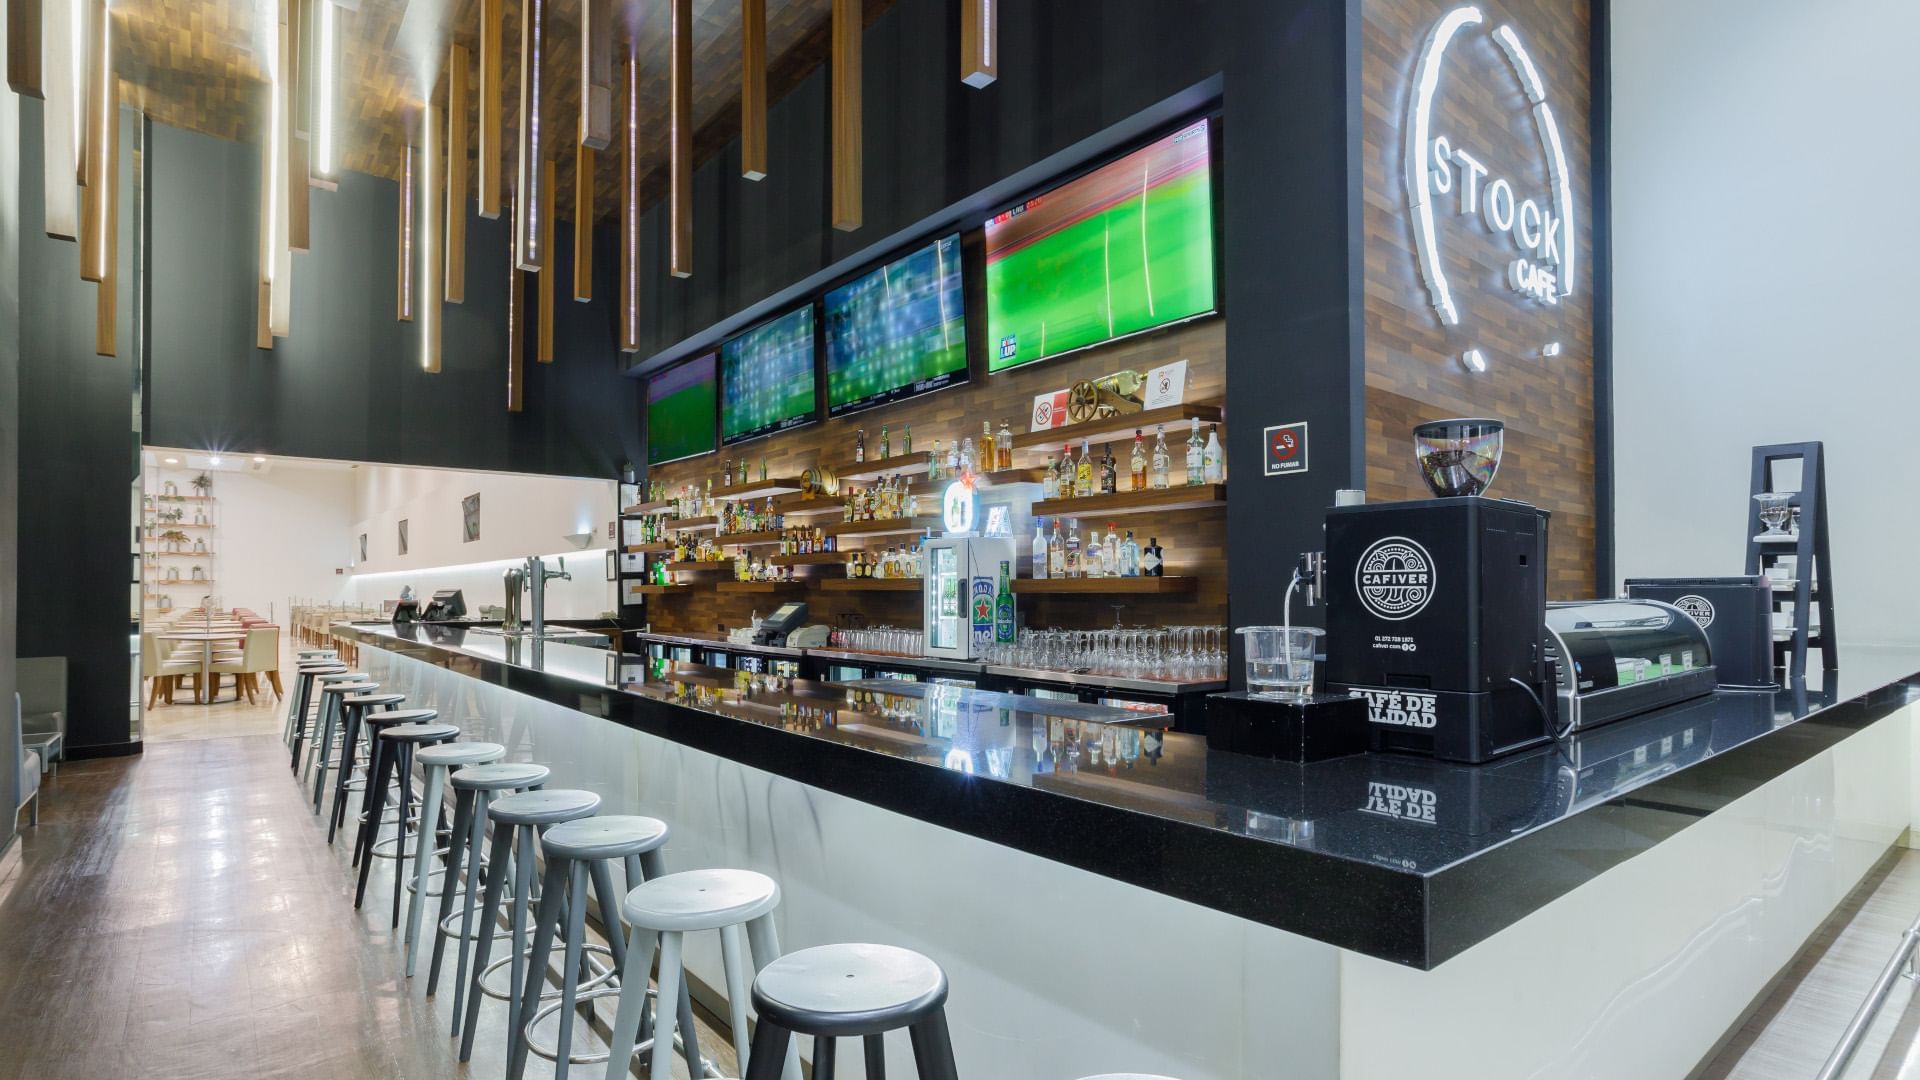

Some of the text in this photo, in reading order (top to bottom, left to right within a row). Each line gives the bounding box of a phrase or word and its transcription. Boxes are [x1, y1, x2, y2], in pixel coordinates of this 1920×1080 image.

[1432, 135, 1560, 265] STOCK
[1280, 460, 1300, 469] FUMAR
[1362, 573, 1428, 585] CAFIVER
[1406, 695, 1436, 713] DE
